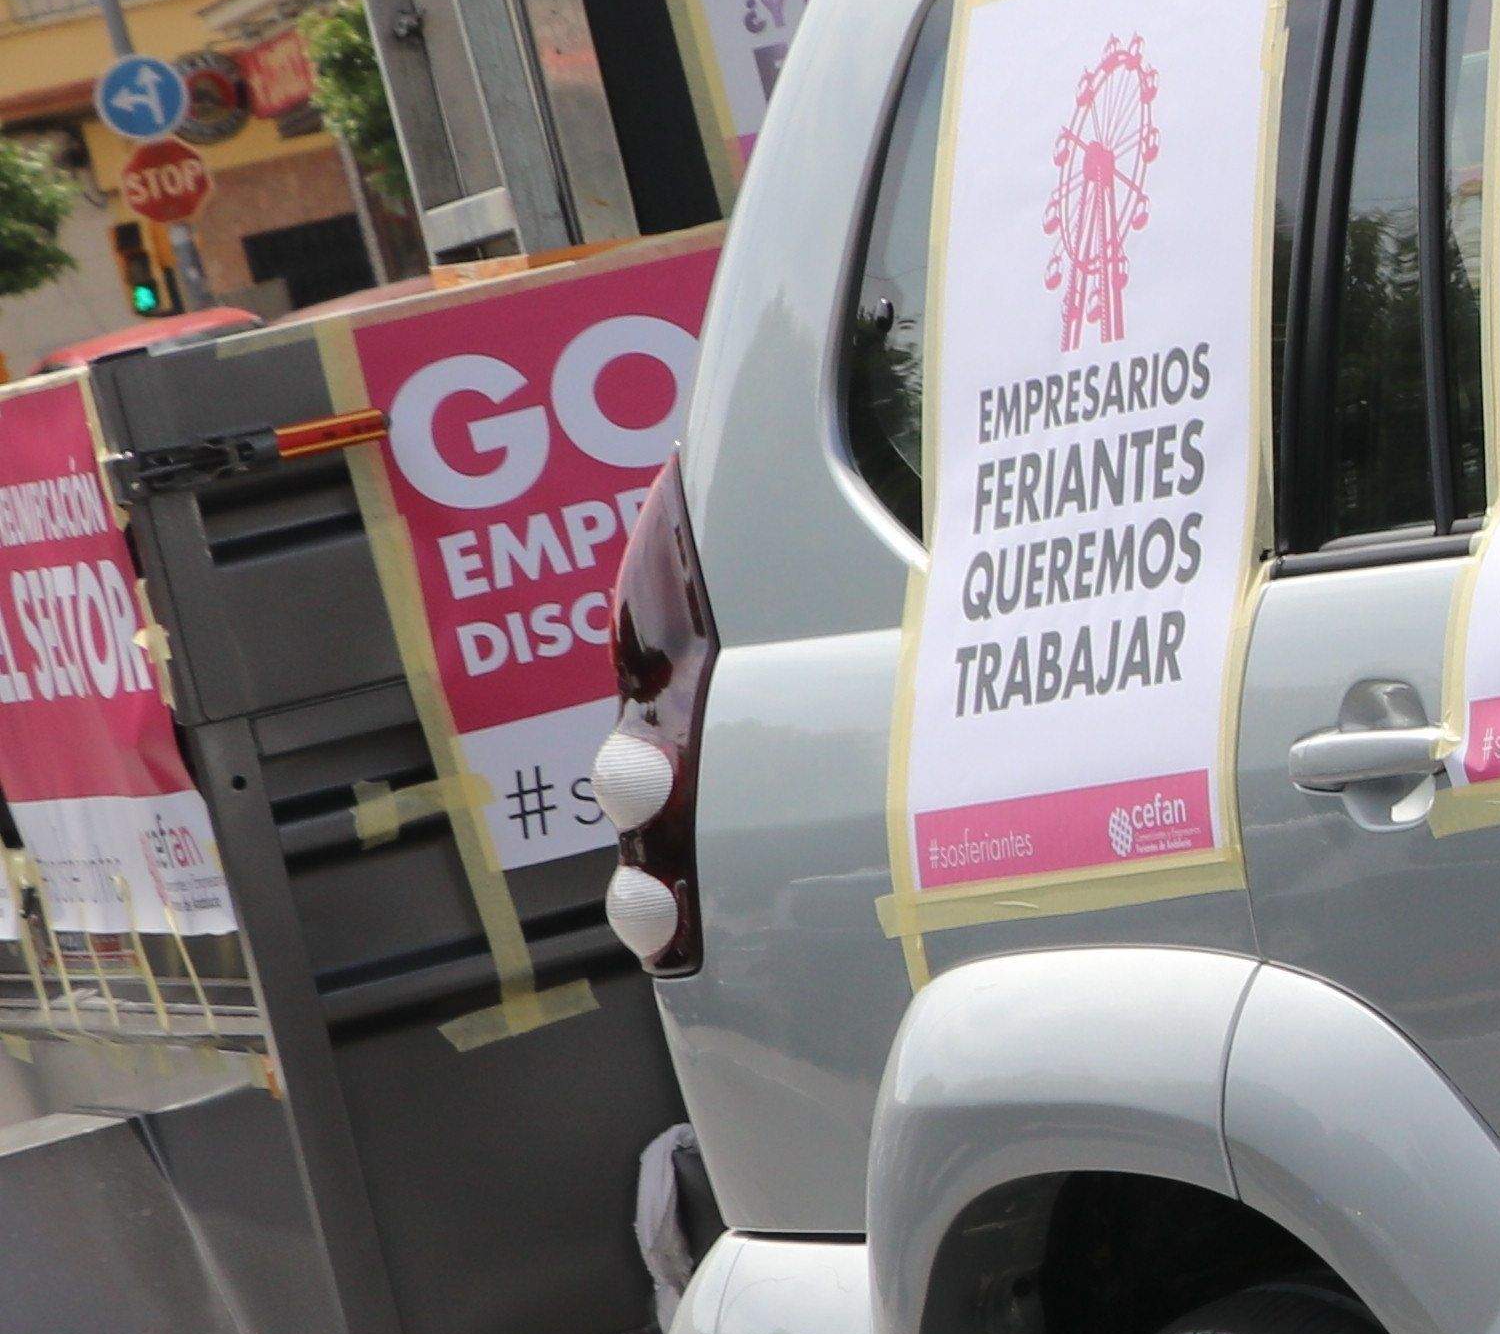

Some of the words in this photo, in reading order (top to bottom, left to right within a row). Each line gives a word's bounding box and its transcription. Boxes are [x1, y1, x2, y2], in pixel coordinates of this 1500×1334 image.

[126, 157, 206, 204] STOP
[977, 341, 1212, 445] EMPRESARIOS
[972, 418, 1206, 536] FERIANTES
[961, 511, 1205, 623] QUEREMOS
[9, 558, 153, 701] SECTOR
[954, 609, 1187, 719] TRABAJAR
[928, 827, 1034, 869] #sosferiantes
[1131, 791, 1187, 829] cefan
